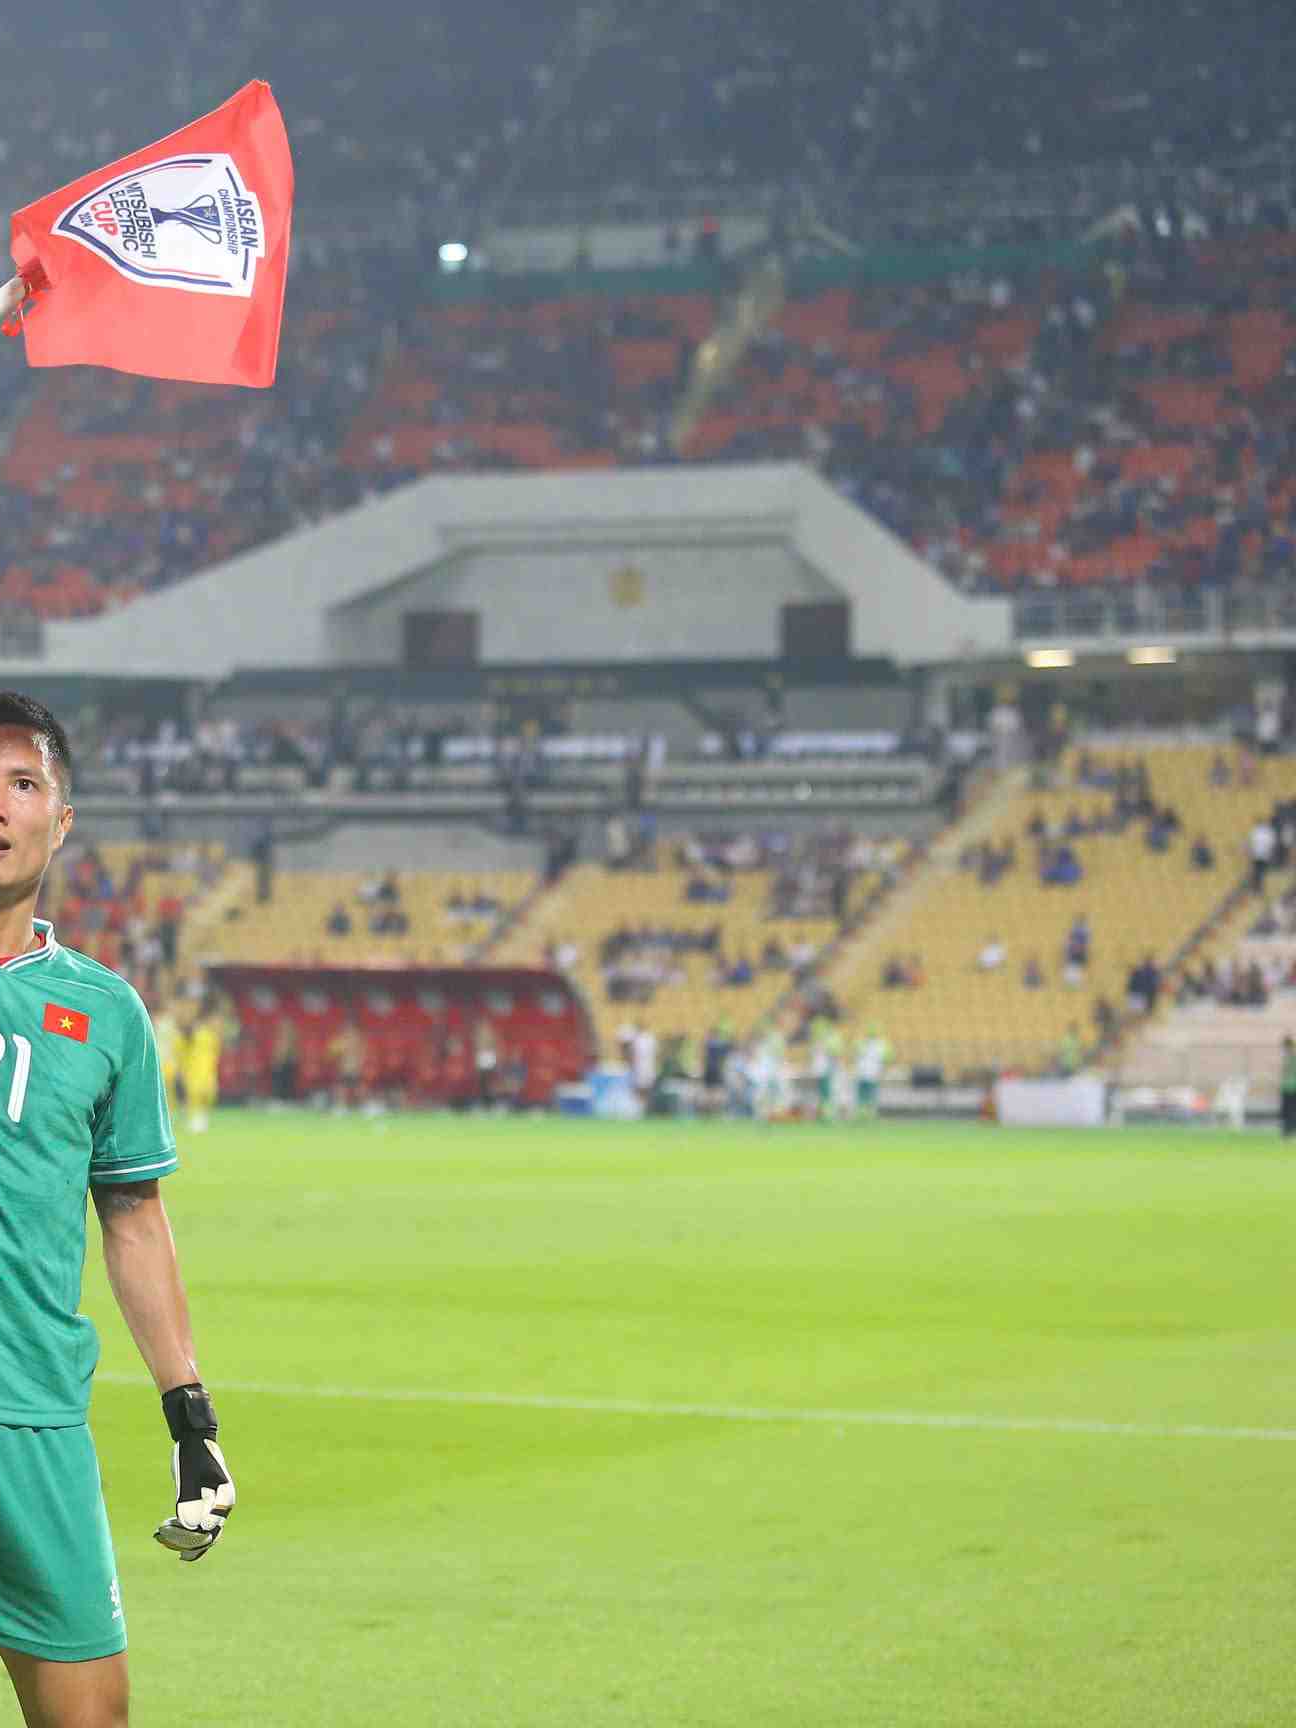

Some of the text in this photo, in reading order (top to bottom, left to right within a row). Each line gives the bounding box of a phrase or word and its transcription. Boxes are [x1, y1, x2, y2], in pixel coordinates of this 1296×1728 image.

[90, 200, 118, 235] CUP
[109, 190, 138, 251] ELECTRIC
[217, 189, 238, 254] CHAMPIONSHIP
[234, 198, 258, 248] ASEAN
